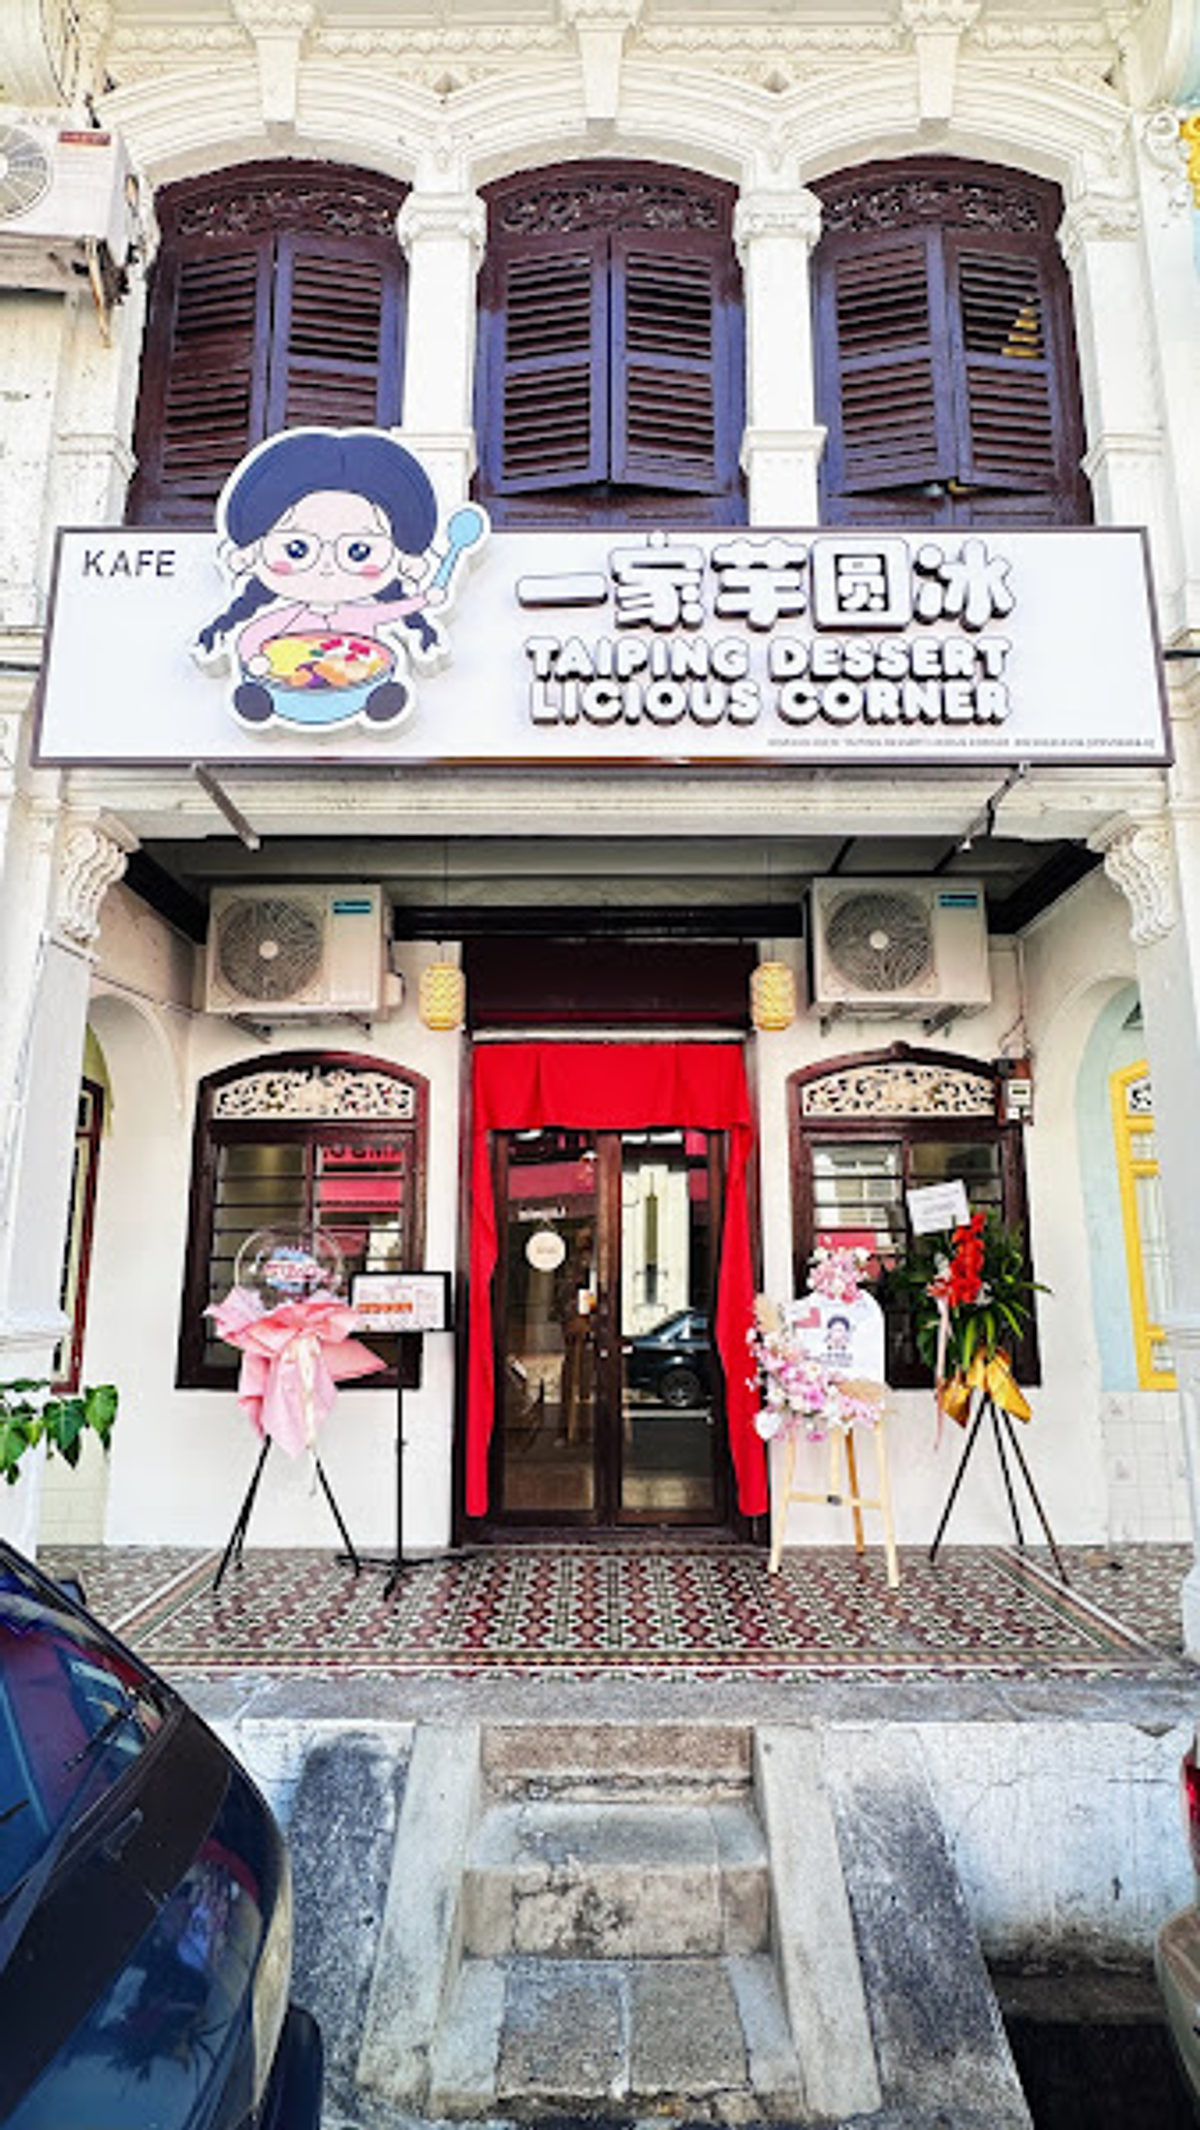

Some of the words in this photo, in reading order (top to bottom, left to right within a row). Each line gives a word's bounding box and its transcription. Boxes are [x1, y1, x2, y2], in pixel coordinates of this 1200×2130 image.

[81, 549, 176, 578] KAFE
[515, 533, 1016, 634] 一家芋圆冰
[523, 636, 750, 683] TAIPING
[768, 636, 1012, 683] DESSERT
[530, 679, 760, 727] LICIOUS
[777, 679, 1012, 727] CORNER
